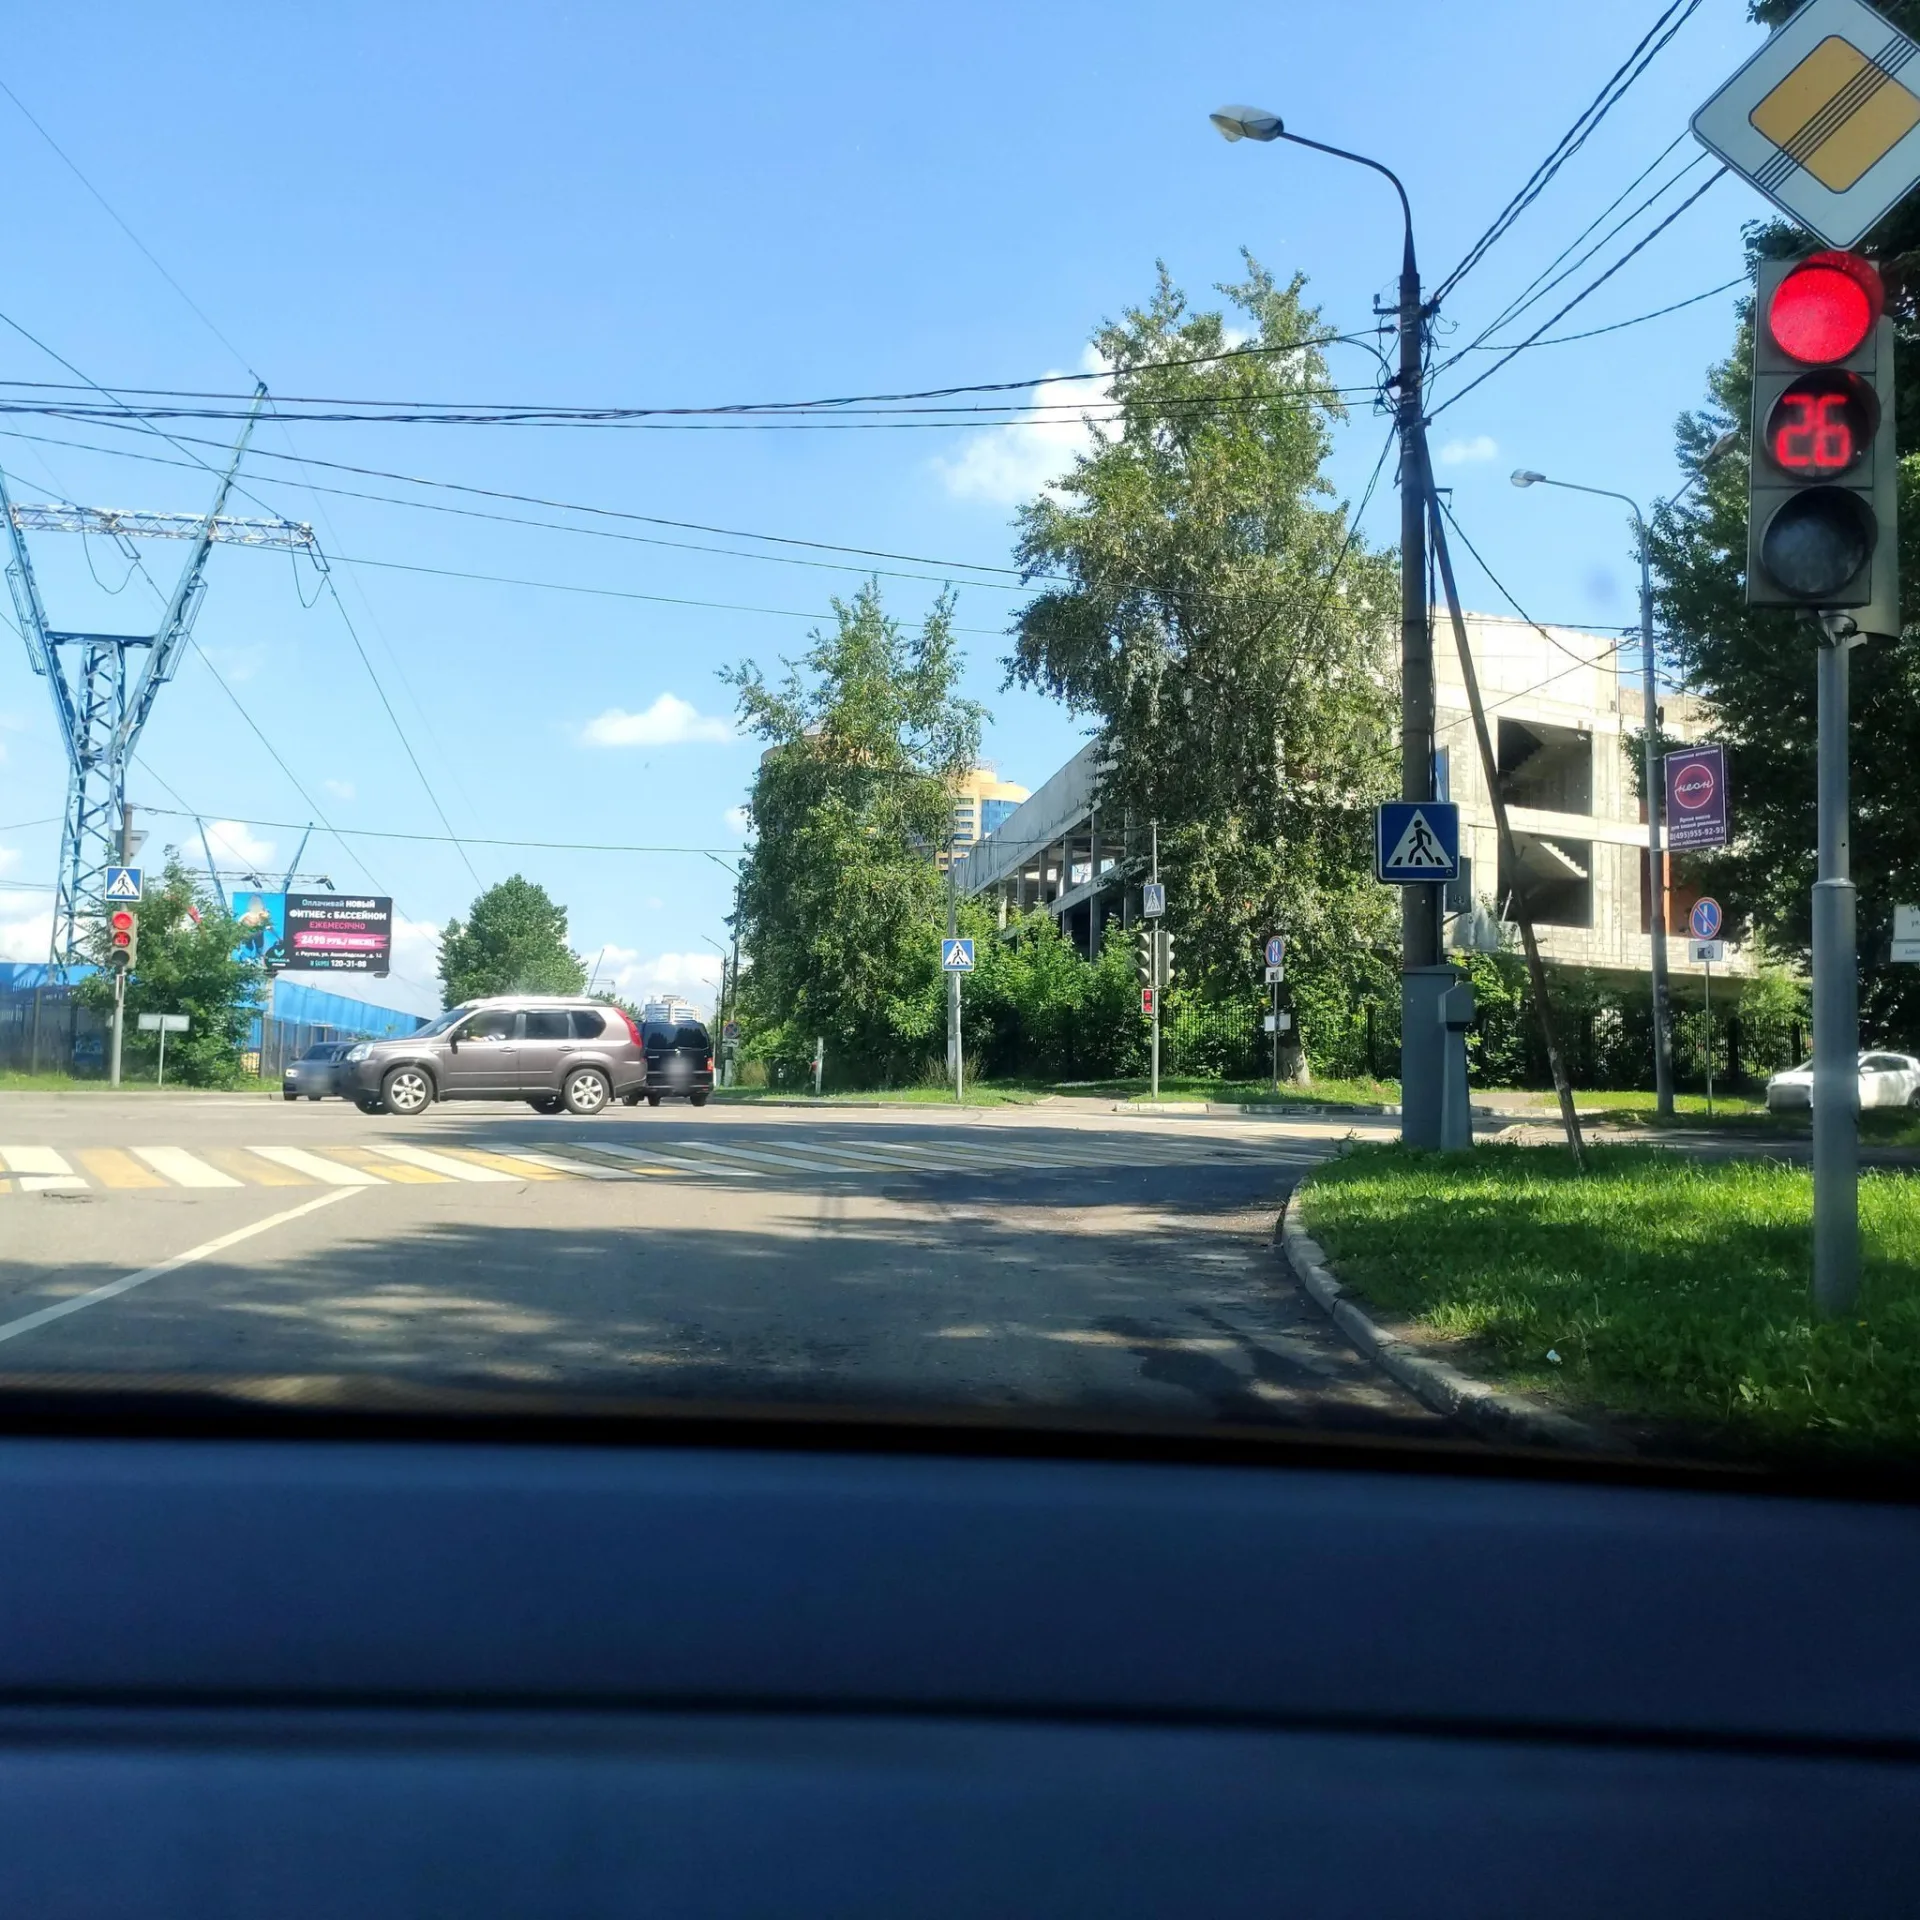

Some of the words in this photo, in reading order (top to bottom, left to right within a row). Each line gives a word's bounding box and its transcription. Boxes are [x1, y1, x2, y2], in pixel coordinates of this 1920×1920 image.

[1776, 393, 1851, 467] 26
[302, 899, 344, 907] Оплачивай
[346, 899, 375, 908] НОВЫЙ
[289, 909, 326, 919] ФИТНЕС
[333, 910, 386, 920] БАССЕЙНОМ
[309, 921, 365, 930] ЕЖЕМЕСЯЧНО
[301, 935, 325, 944] 2490
